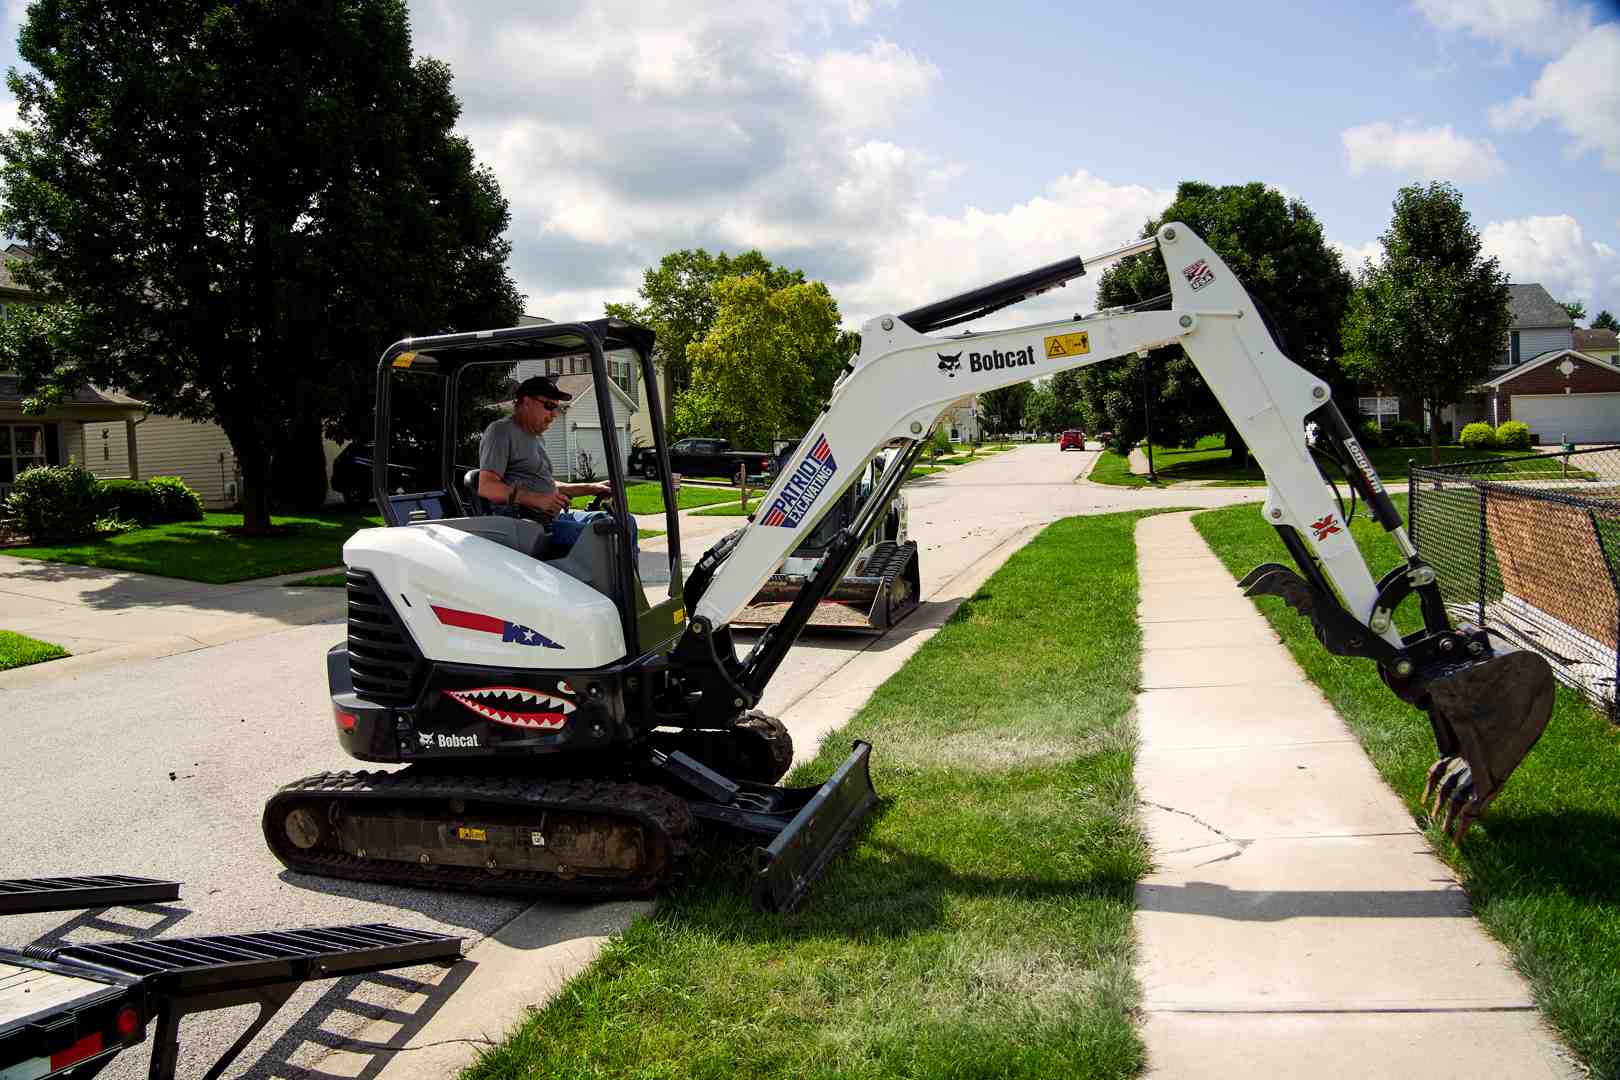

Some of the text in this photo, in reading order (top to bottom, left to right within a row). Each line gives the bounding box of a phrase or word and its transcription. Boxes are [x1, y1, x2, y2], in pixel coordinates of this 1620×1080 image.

[969, 346, 1035, 372] Bobcat
[774, 455, 822, 514] PATRIOT
[788, 466, 832, 522] EXCAVATING
[437, 734, 478, 748] Bobcat
